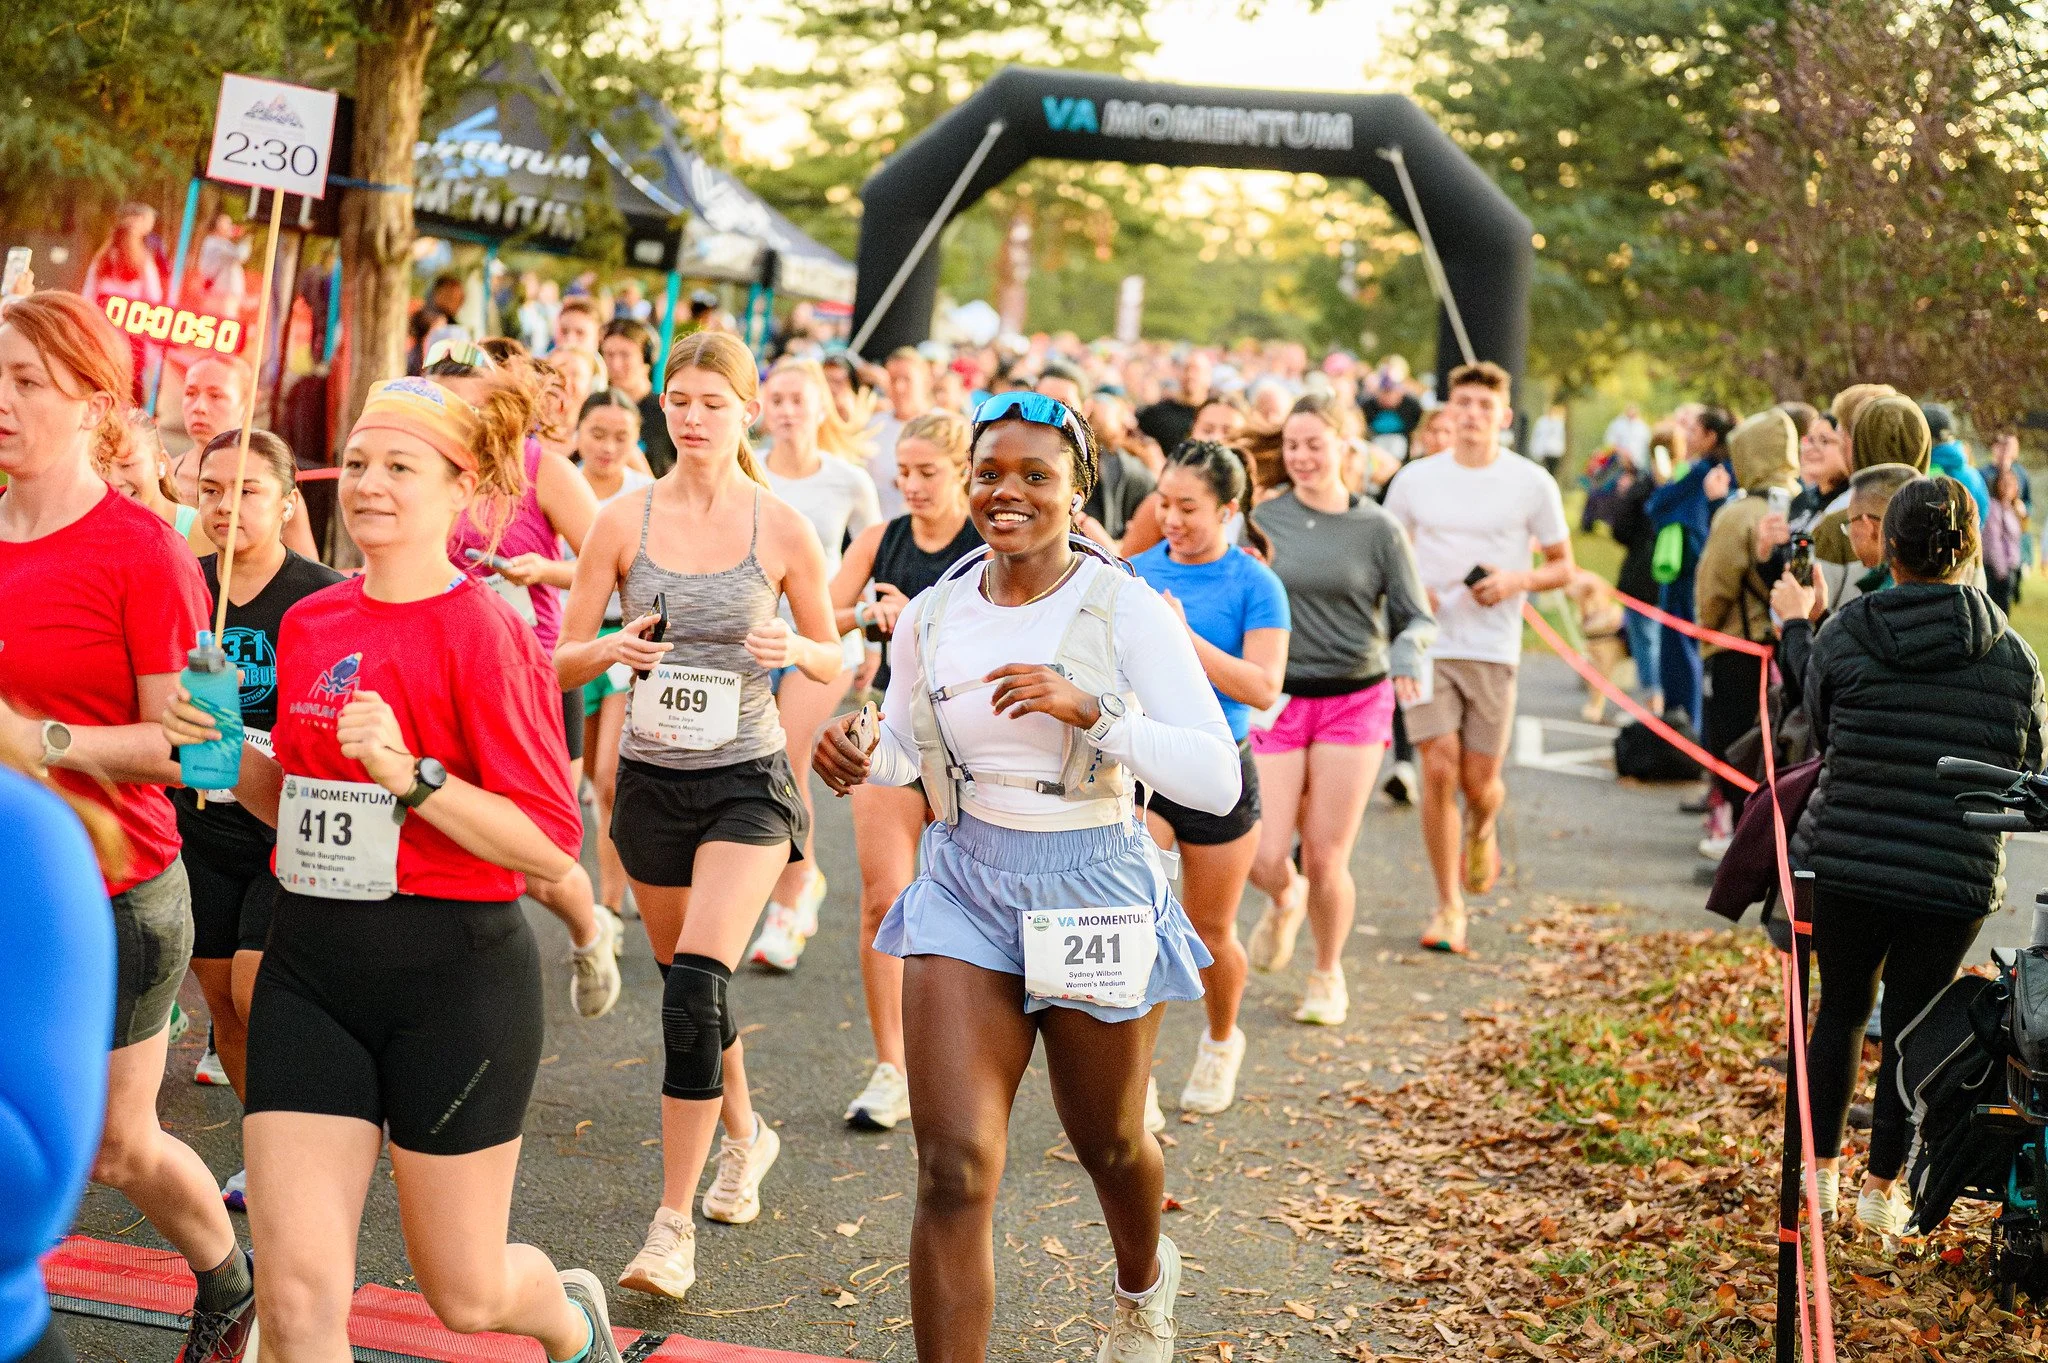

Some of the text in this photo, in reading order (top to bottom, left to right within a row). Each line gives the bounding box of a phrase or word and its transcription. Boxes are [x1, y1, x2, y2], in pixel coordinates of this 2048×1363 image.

[1042, 96, 1354, 149] VA MOMENTUM
[223, 131, 318, 177] 2:30
[105, 295, 241, 354] 00:00:50
[222, 630, 265, 662] 3.1
[657, 670, 736, 687] VA MOMENTUM
[659, 686, 708, 713] 469
[244, 732, 273, 748] NTUM
[310, 787, 393, 806] MOMENTUM
[298, 808, 353, 846] 413
[1057, 916, 1076, 928] VA
[1063, 933, 1121, 966] 241
[1065, 980, 1099, 989] Women's
[1068, 970, 1123, 982] Sydney Wilborn
